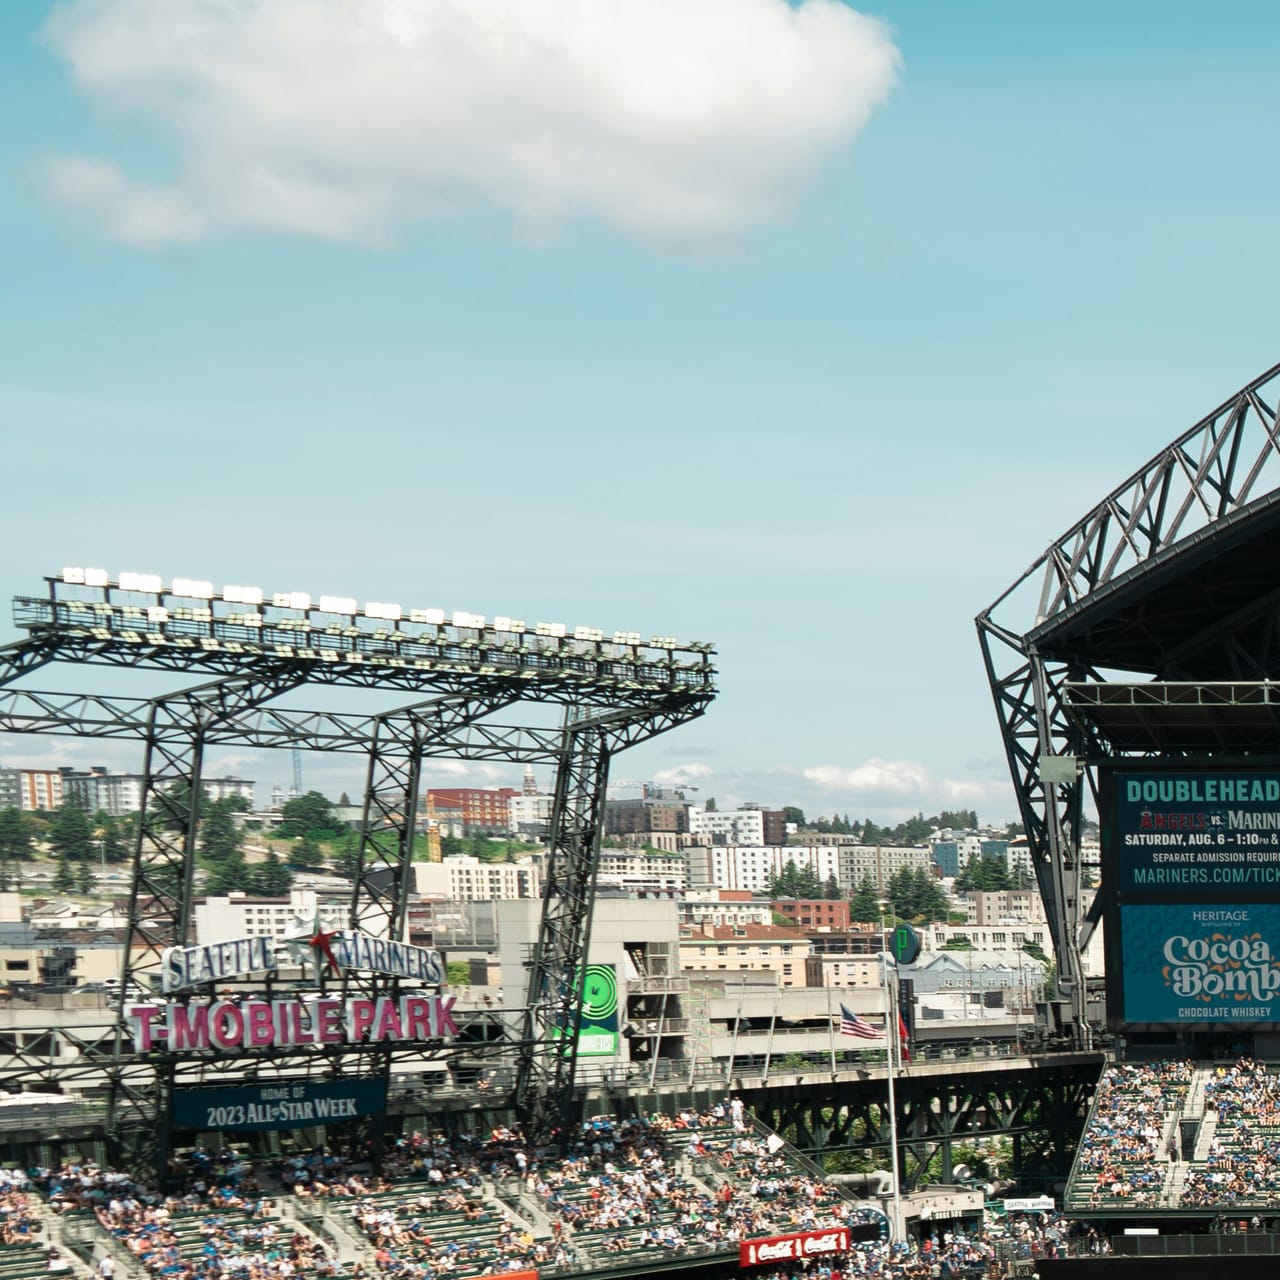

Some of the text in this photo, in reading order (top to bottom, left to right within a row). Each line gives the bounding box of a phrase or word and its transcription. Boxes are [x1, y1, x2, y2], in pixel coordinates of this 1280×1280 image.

[1140, 808, 1206, 830] ANGELS
[1125, 833, 1187, 847] SATURDAY,
[1188, 834, 1215, 846] AUG.
[1217, 834, 1225, 845] 6
[1152, 853, 1195, 863] SEPARATE
[1196, 852, 1245, 863] ADMISSION
[1192, 911, 1249, 921] HERITAGE
[167, 936, 275, 988] SEATTLE
[336, 931, 442, 985] MARINERS
[1163, 935, 1271, 974] Cocoa
[1178, 1007, 1271, 1018] CHOCOLATE WHISKEY
[126, 996, 460, 1052] T-MOBILE PARK
[260, 1086, 305, 1100] HOME OF
[207, 1104, 246, 1127] 2023
[314, 1097, 358, 1119] WEEK
